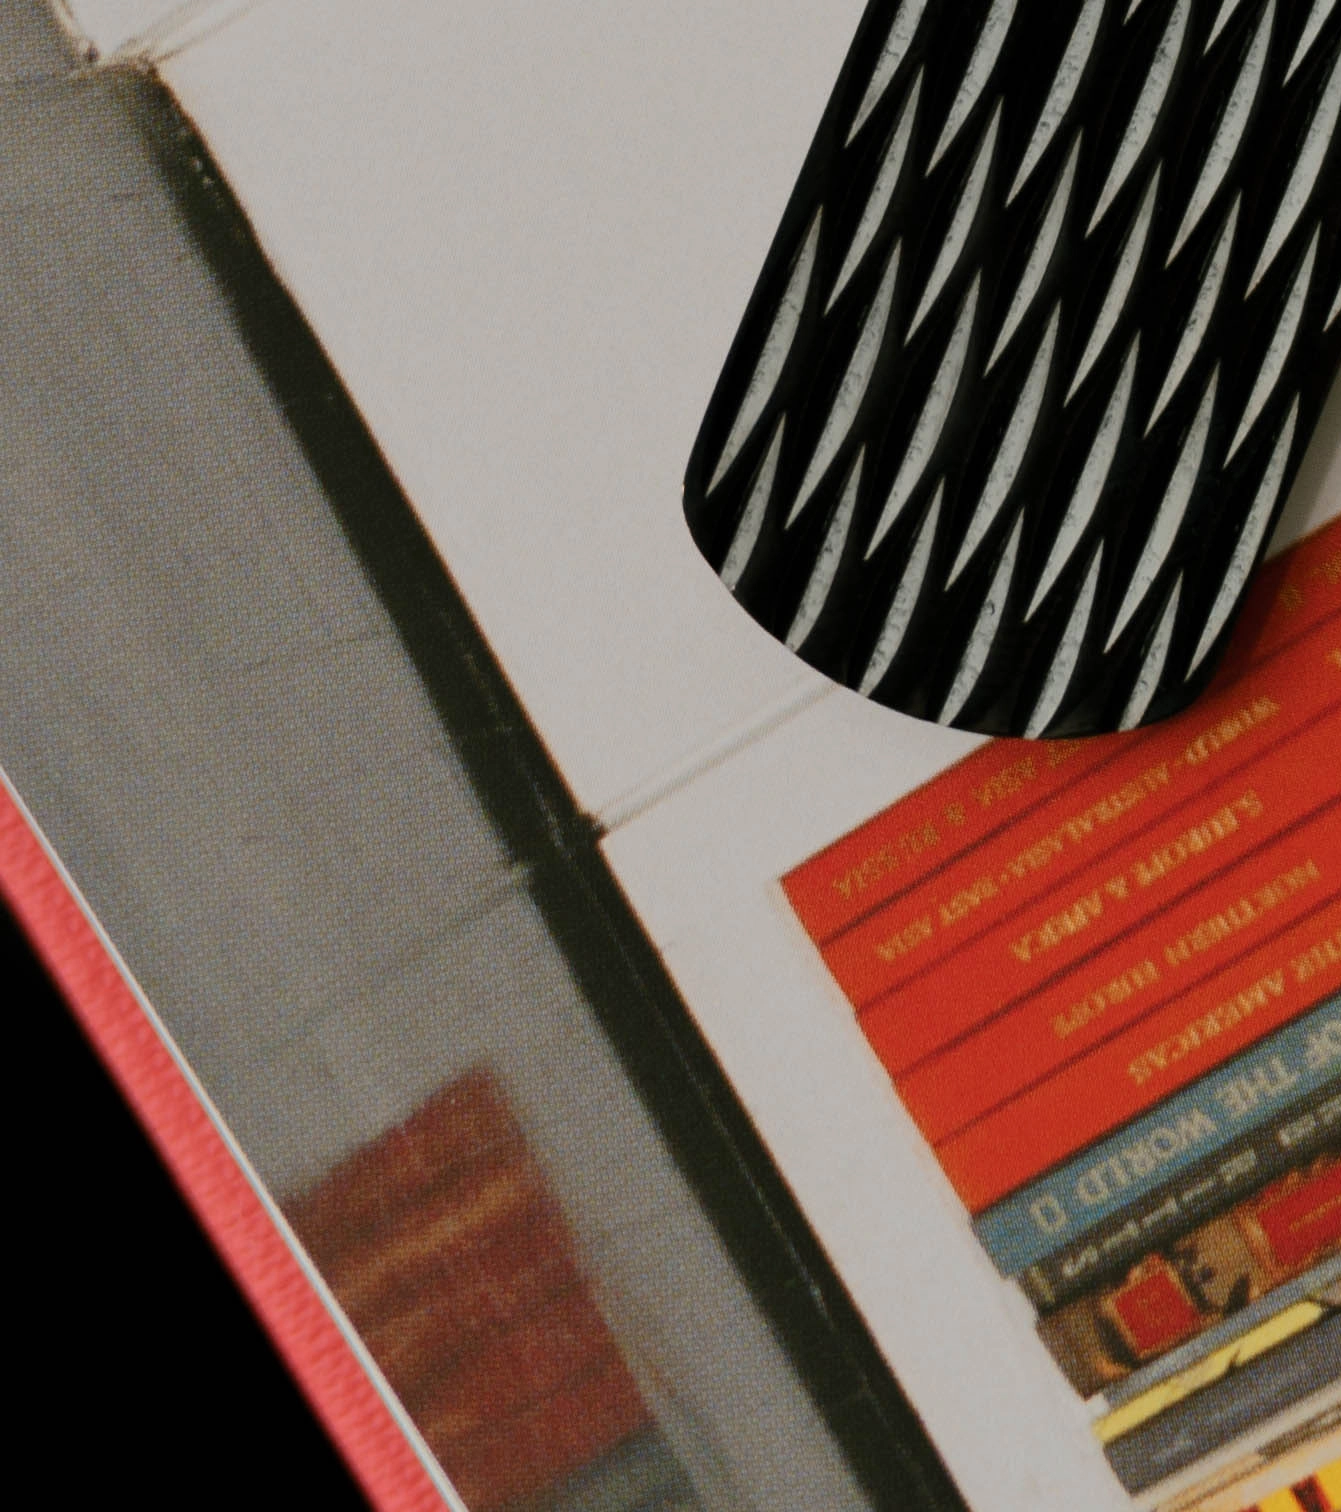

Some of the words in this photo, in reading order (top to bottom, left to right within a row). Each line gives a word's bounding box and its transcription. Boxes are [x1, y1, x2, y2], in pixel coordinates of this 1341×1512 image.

[1123, 968, 1290, 1085] AMERICAS
[1214, 1053, 1295, 1118] THE
[1071, 1102, 1215, 1206] WORLD
